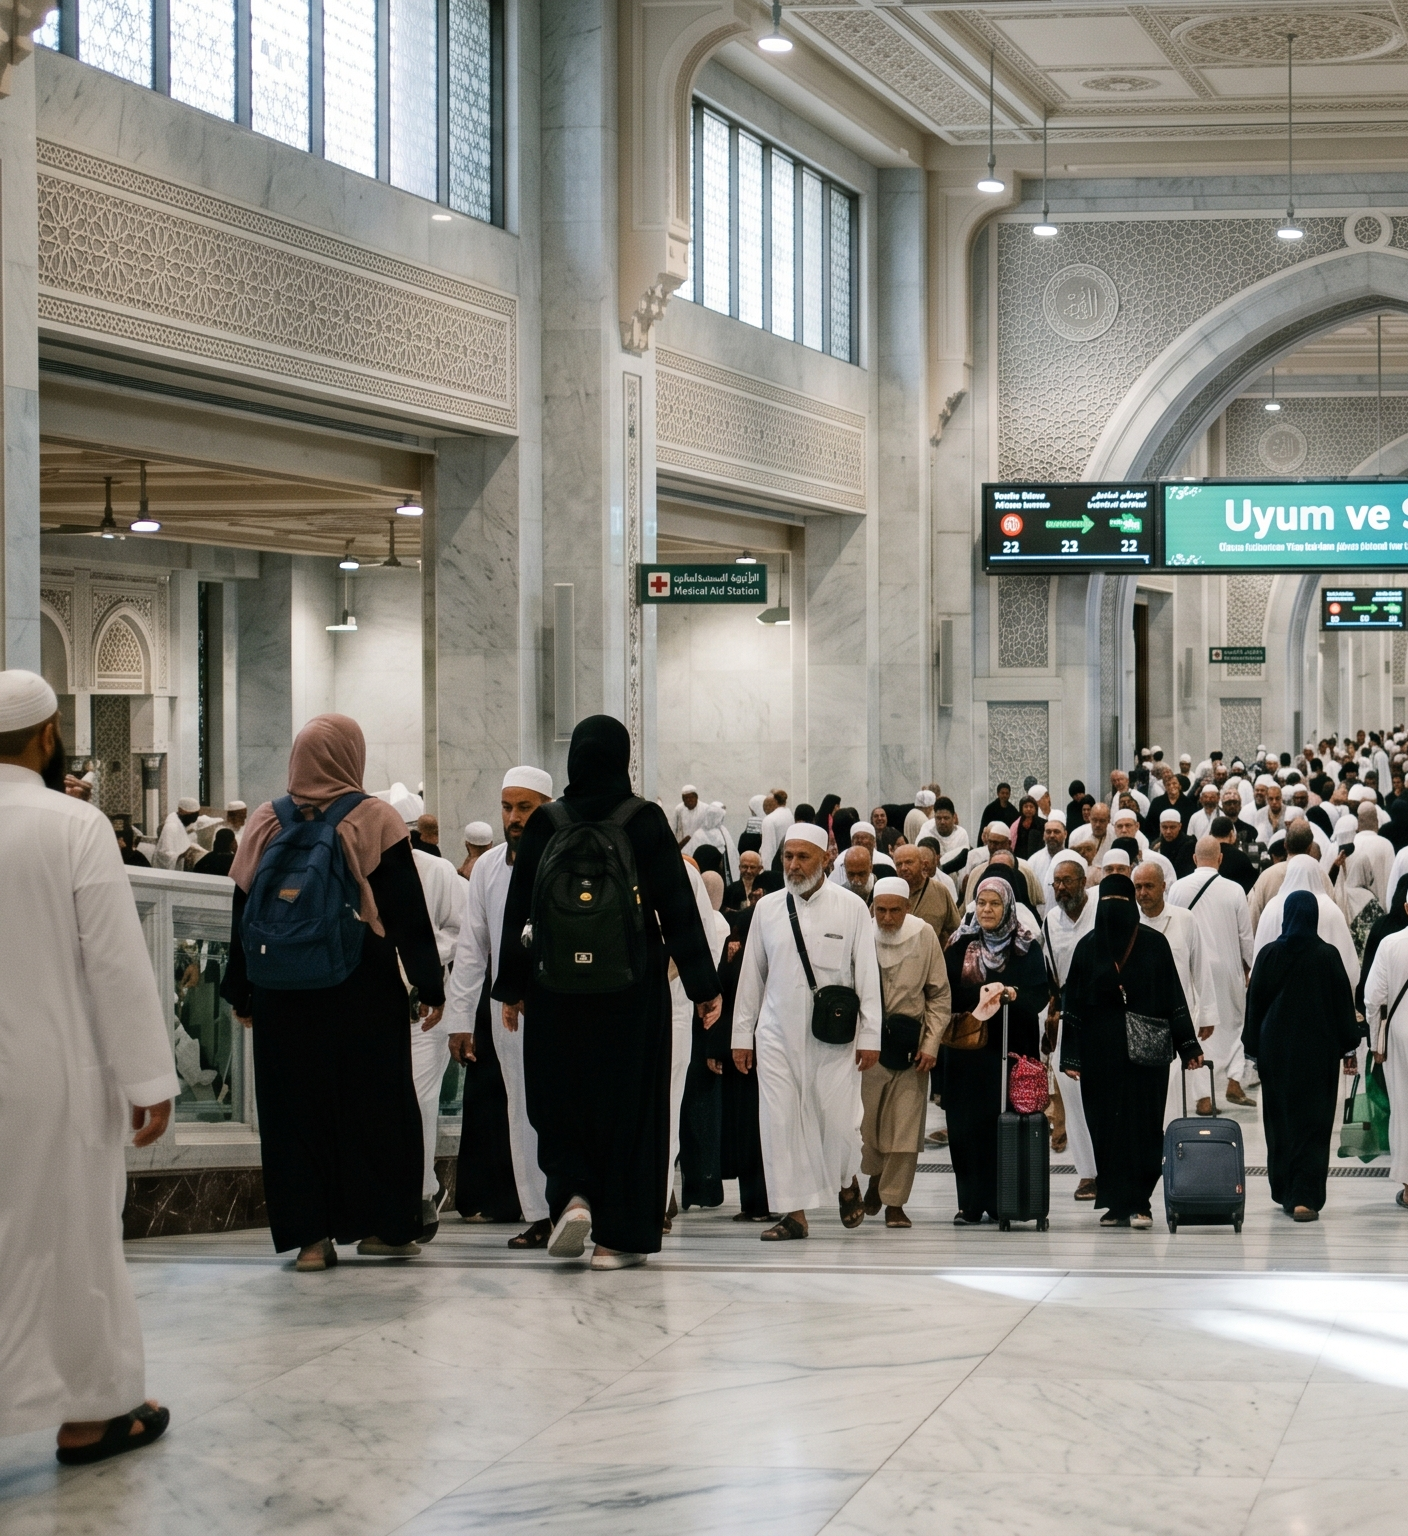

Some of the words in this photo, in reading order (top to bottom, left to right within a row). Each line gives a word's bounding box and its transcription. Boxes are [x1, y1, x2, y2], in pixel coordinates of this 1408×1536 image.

[1225, 498, 1335, 540] Uyum
[1345, 504, 1391, 531] ve
[1002, 541, 1020, 553] 22
[710, 586, 725, 595] Aid
[727, 586, 760, 595] Station
